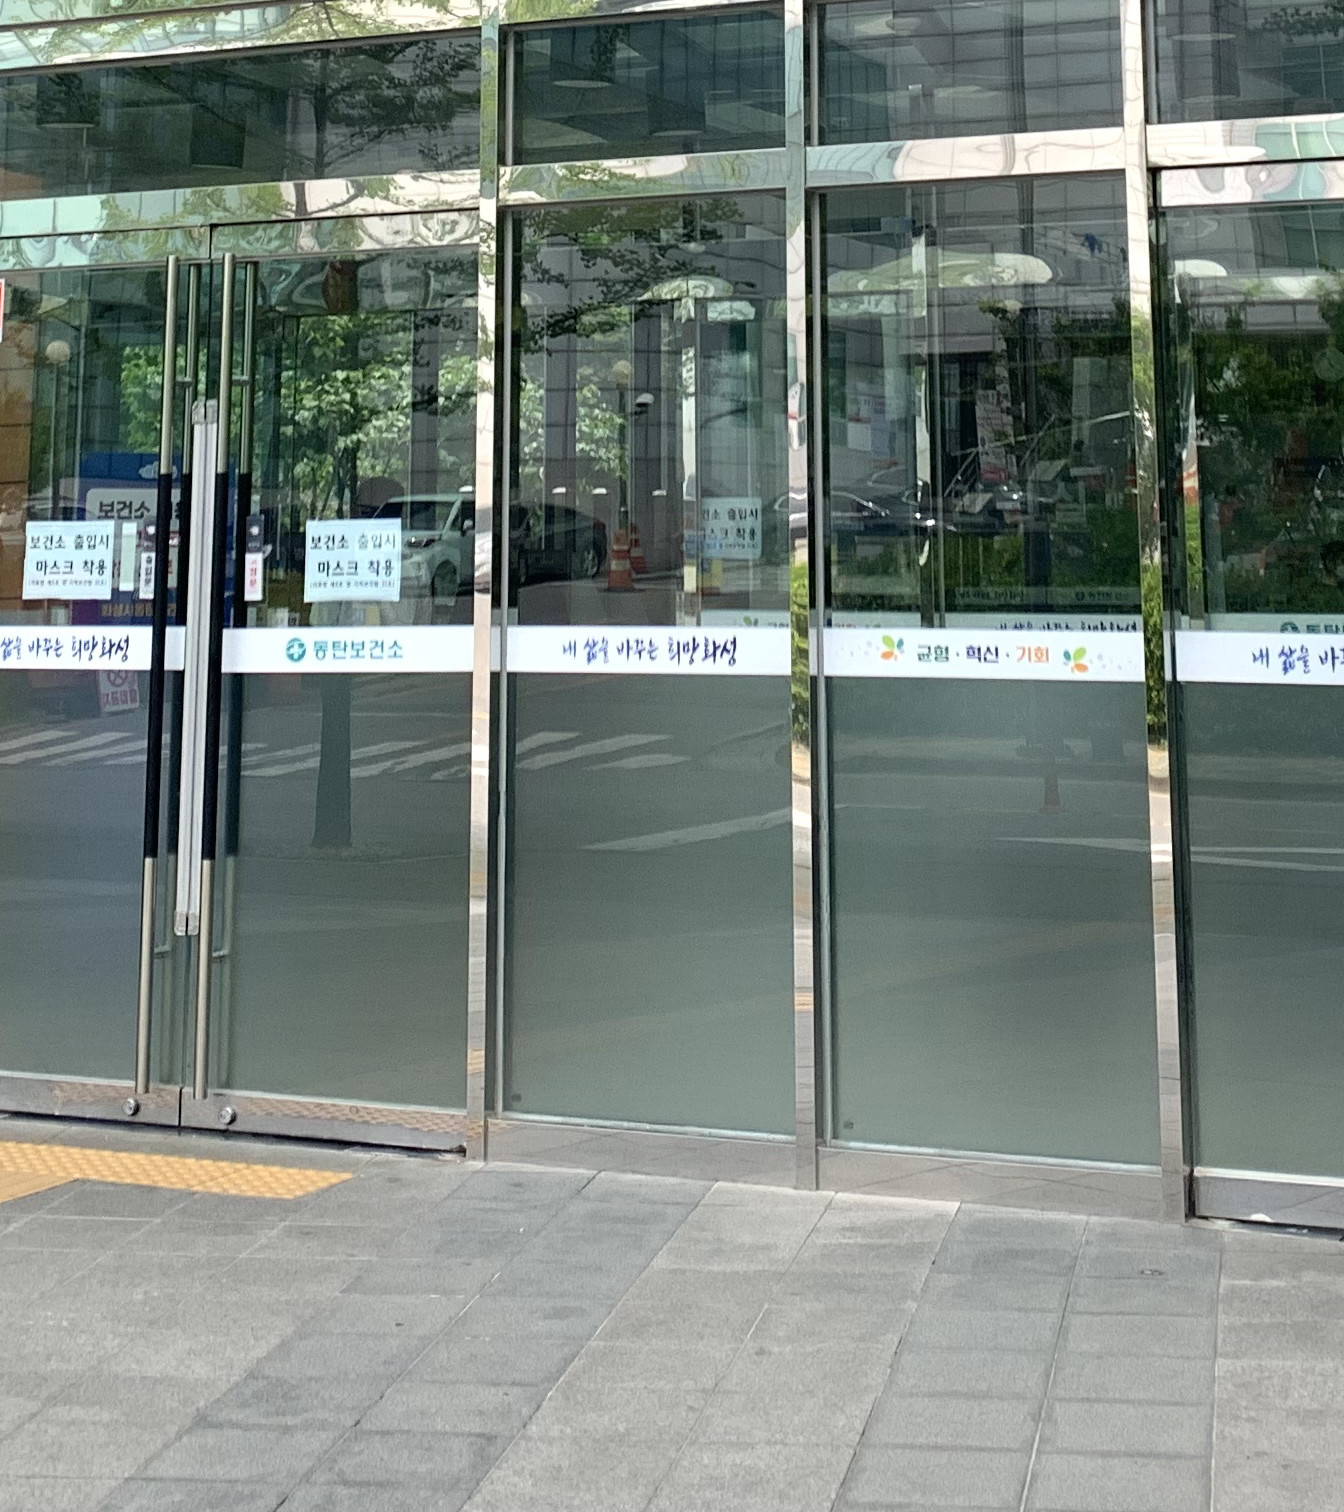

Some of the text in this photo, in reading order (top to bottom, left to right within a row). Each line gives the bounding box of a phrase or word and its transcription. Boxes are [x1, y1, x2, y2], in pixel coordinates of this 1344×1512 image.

[30, 534, 110, 551] 보건소 출입시
[310, 533, 396, 551] 보건소 출입시
[36, 559, 108, 577] 마스크 착용
[317, 558, 394, 577] 마스크 착용
[28, 637, 64, 659] 바꾸는
[313, 639, 404, 662] 동탄보건소
[562, 639, 577, 658] 내
[616, 638, 659, 661] 바꾸는
[916, 644, 1050, 664] 균형 혁신 기회
[1252, 647, 1270, 668] 내
[1278, 644, 1311, 675] 삶을
